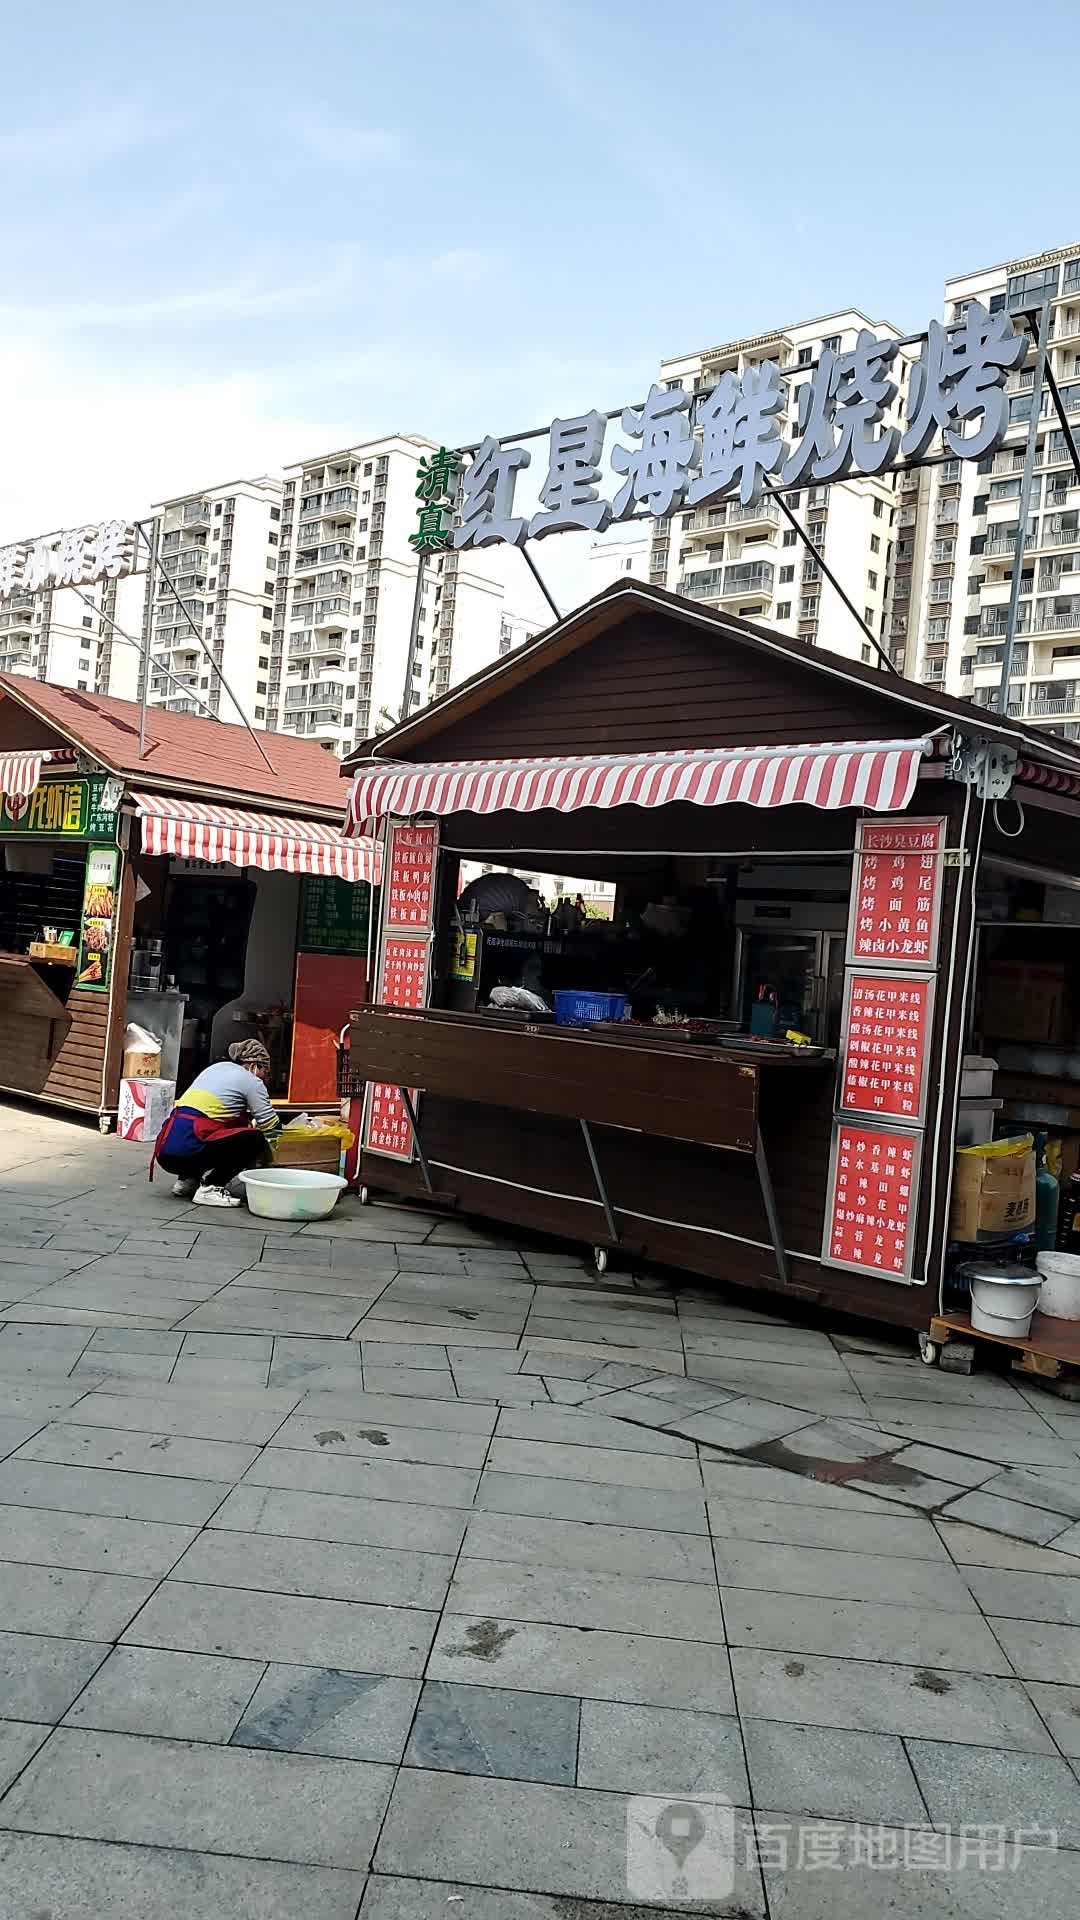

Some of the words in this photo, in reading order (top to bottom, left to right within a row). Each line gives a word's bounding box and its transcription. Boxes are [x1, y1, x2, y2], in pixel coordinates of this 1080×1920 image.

[454, 300, 1030, 549] 红星海鲜烧烤
[408, 446, 464, 553] 清真
[868, 832, 935, 848] 长沙臭豆腐
[864, 854, 933, 870] 烤鸡翅
[863, 875, 932, 891] 烤鸡尾
[861, 897, 931, 912] 烤面筋
[860, 917, 929, 933] 烤小黄鱼
[859, 938, 929, 954] 辣卤小龙虾
[853, 988, 921, 1005] 清汤花甲米线
[852, 1005, 920, 1023] 香辣花甲米线
[850, 1023, 918, 1040] 酸汤花甲米线
[848, 1057, 916, 1076] 酸辣花甲米线
[846, 1091, 913, 1112] 花甲粉
[372, 1115, 408, 1135] 广东河粉
[371, 1130, 407, 1150] 黄金炸洋芋
[841, 1138, 912, 1161] 爆炒香辣虾
[840, 1156, 911, 1180] 盐水基围虾
[839, 1174, 909, 1197] 香辣田螺
[837, 1191, 908, 1215] 爆炒花甲
[836, 1208, 906, 1233] 爆炒麻辣小龙虾
[833, 1243, 903, 1269] 香辣龙虾
